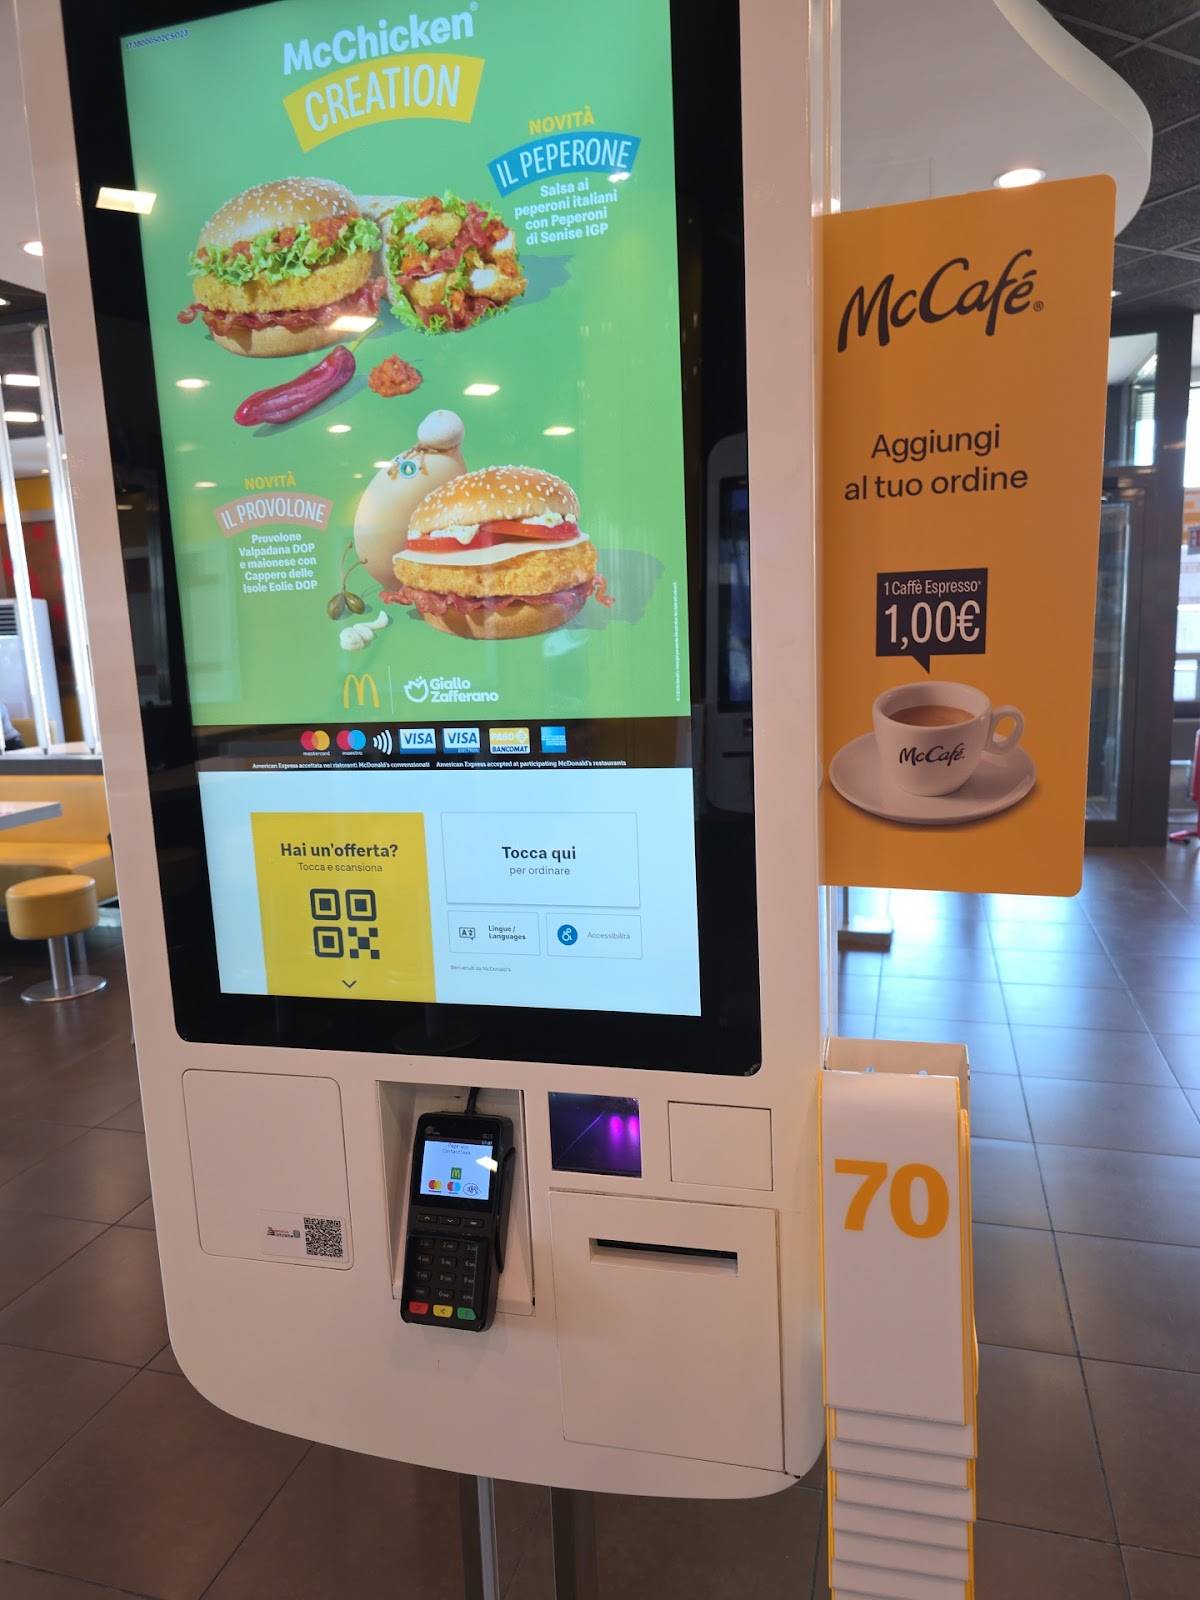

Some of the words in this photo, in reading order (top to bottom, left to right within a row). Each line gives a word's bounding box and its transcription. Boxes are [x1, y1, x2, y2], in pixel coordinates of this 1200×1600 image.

[305, 64, 460, 132] CREATION
[528, 105, 595, 135] NOVITÀ
[496, 160, 519, 188] IL
[519, 138, 632, 178] PEPERONE
[540, 182, 575, 197] Salsa
[577, 178, 589, 191] ai
[514, 199, 570, 220] peperoni
[573, 189, 618, 207] italiani
[525, 219, 549, 231] con
[551, 206, 608, 229] Peperoni
[526, 230, 539, 246] di
[540, 227, 583, 244] Senise
[585, 222, 609, 237] IGP
[871, 423, 1001, 463] Aggiungi
[244, 470, 296, 490] NOVITÀ
[844, 475, 868, 501] al
[875, 476, 923, 498] tuo
[931, 466, 1028, 494] ordine
[221, 510, 238, 529] IL
[236, 497, 326, 523] PROVOLONE
[251, 532, 302, 544] Provolone
[238, 545, 291, 558] Valpadana
[292, 543, 315, 554] DOP
[240, 561, 247, 569] e
[248, 557, 296, 568] maionese
[297, 556, 317, 566] con
[245, 570, 287, 582] Cappero
[289, 567, 314, 577] delle
[243, 583, 267, 594] Isole
[269, 581, 293, 592] Eolie
[295, 580, 318, 590] DOP
[884, 582, 889, 596] 1
[892, 579, 922, 596] Caffè
[885, 600, 980, 650] 1,00€
[429, 676, 471, 690] Giallo
[430, 690, 499, 703] Zafferano
[404, 732, 433, 745] VISA
[447, 731, 478, 744] VISA
[359, 761, 390, 769] McDonald's
[464, 760, 486, 768] Express
[487, 760, 513, 768] accepted
[520, 760, 557, 769] participating
[558, 759, 592, 767] McDonald's
[281, 842, 306, 857] Hai
[311, 842, 398, 857] un'offerta?
[502, 846, 547, 860] Tocca
[551, 846, 576, 863] qui
[298, 862, 326, 872] Tocca
[327, 864, 333, 872] e
[335, 863, 383, 873] scansiona
[509, 866, 526, 876] per
[528, 865, 571, 875] ordinare
[488, 925, 512, 934] Lingue
[488, 932, 526, 941] Languages
[834, 1159, 950, 1239] 70
